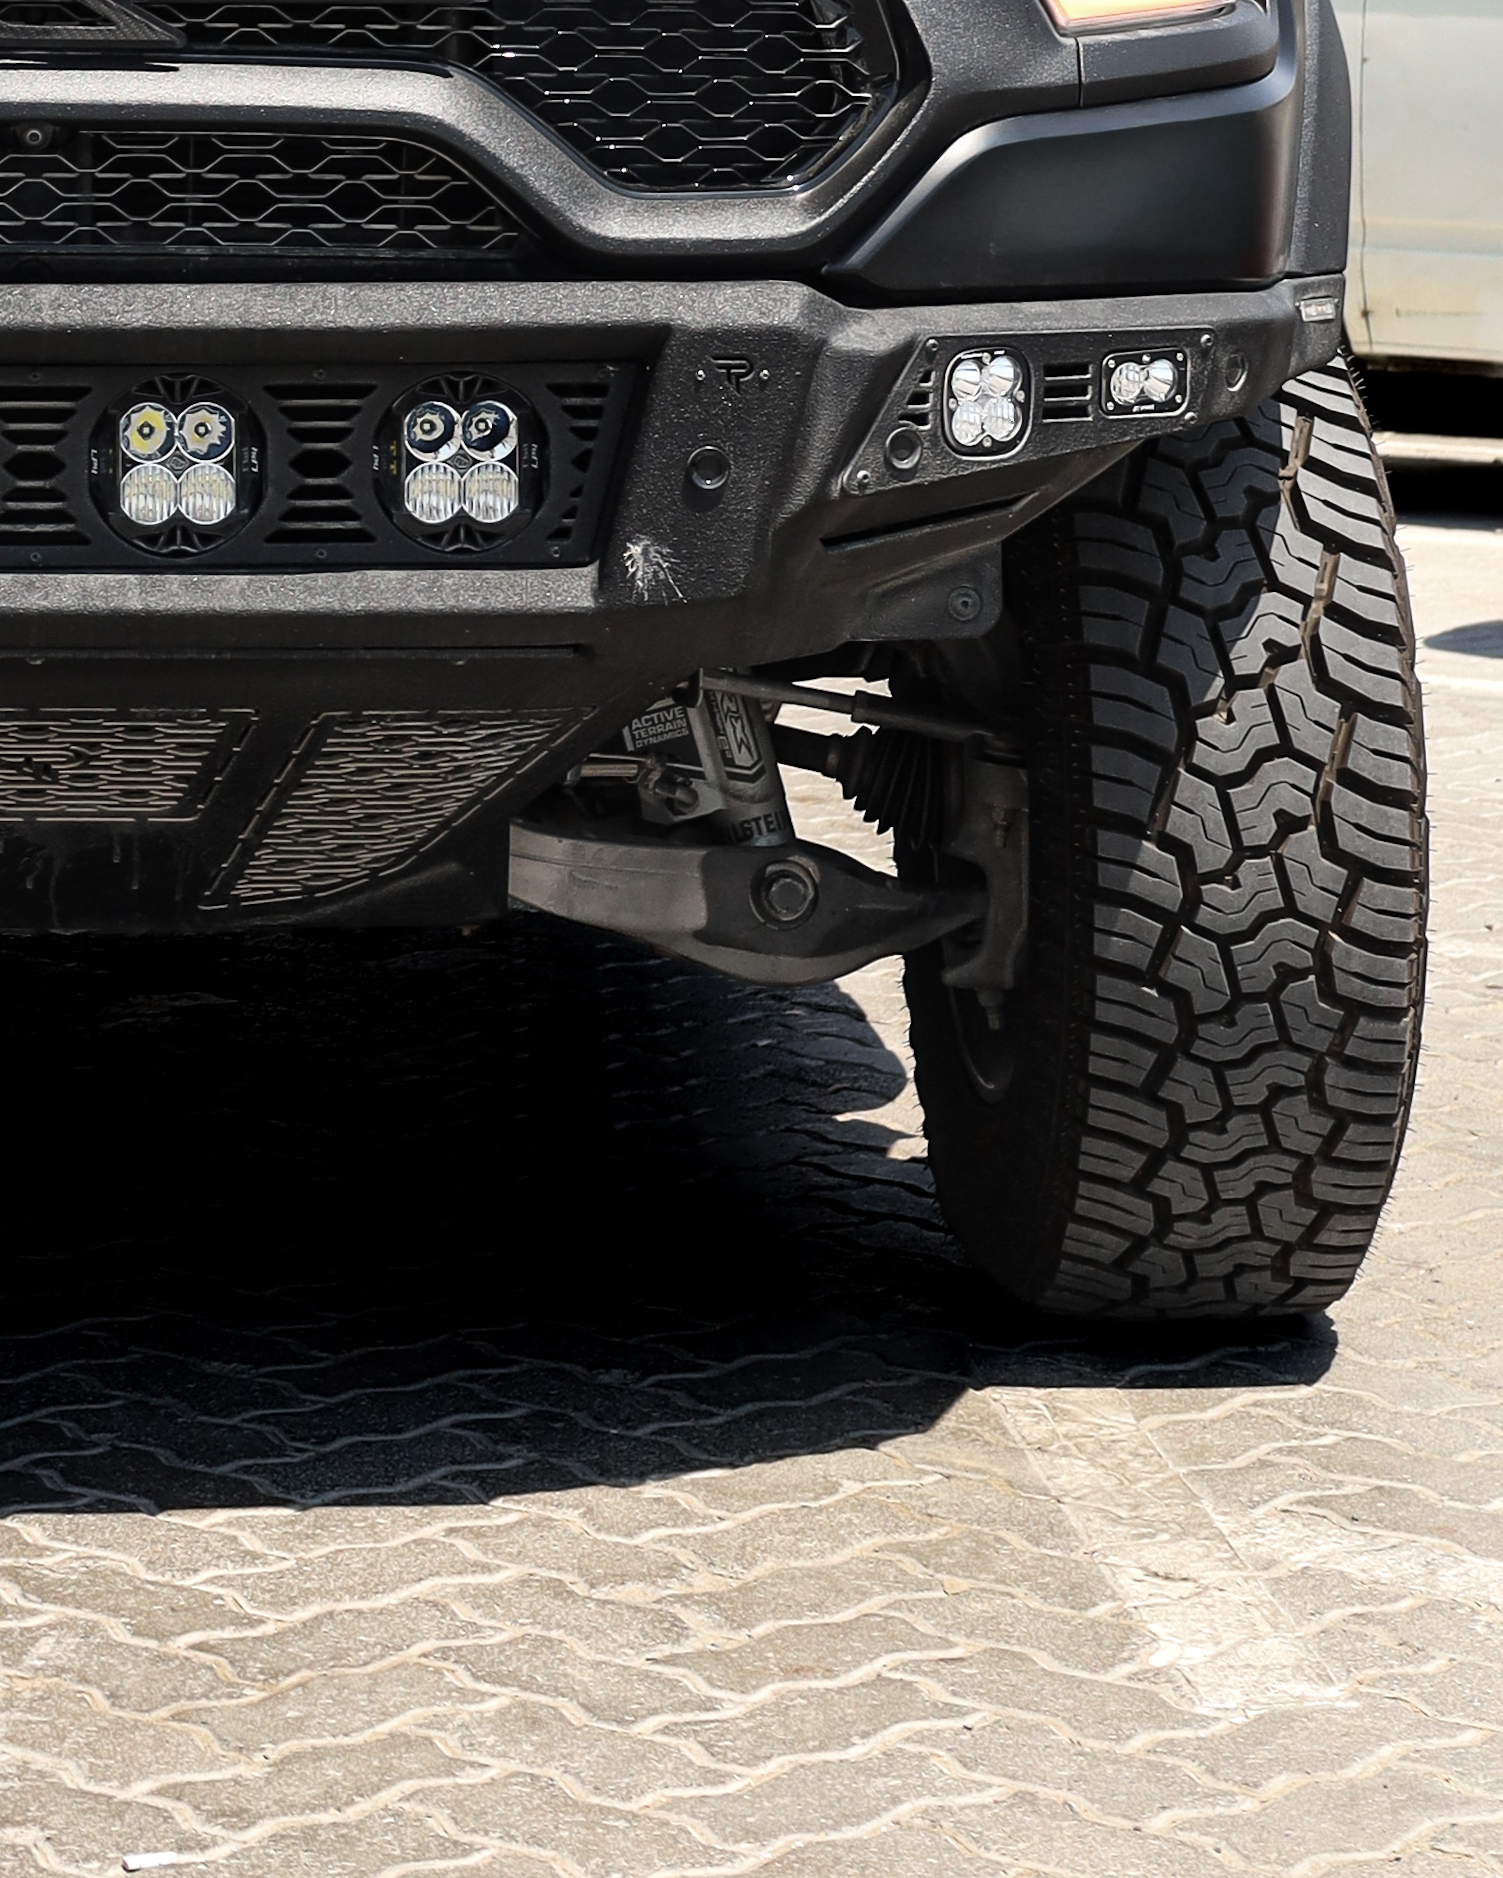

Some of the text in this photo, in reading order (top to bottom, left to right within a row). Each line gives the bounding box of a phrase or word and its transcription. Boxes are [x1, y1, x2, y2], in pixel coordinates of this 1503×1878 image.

[631, 705, 686, 730] ACTIVE
[632, 718, 688, 740] TERRAIN
[635, 728, 690, 748] DYNAMICS
